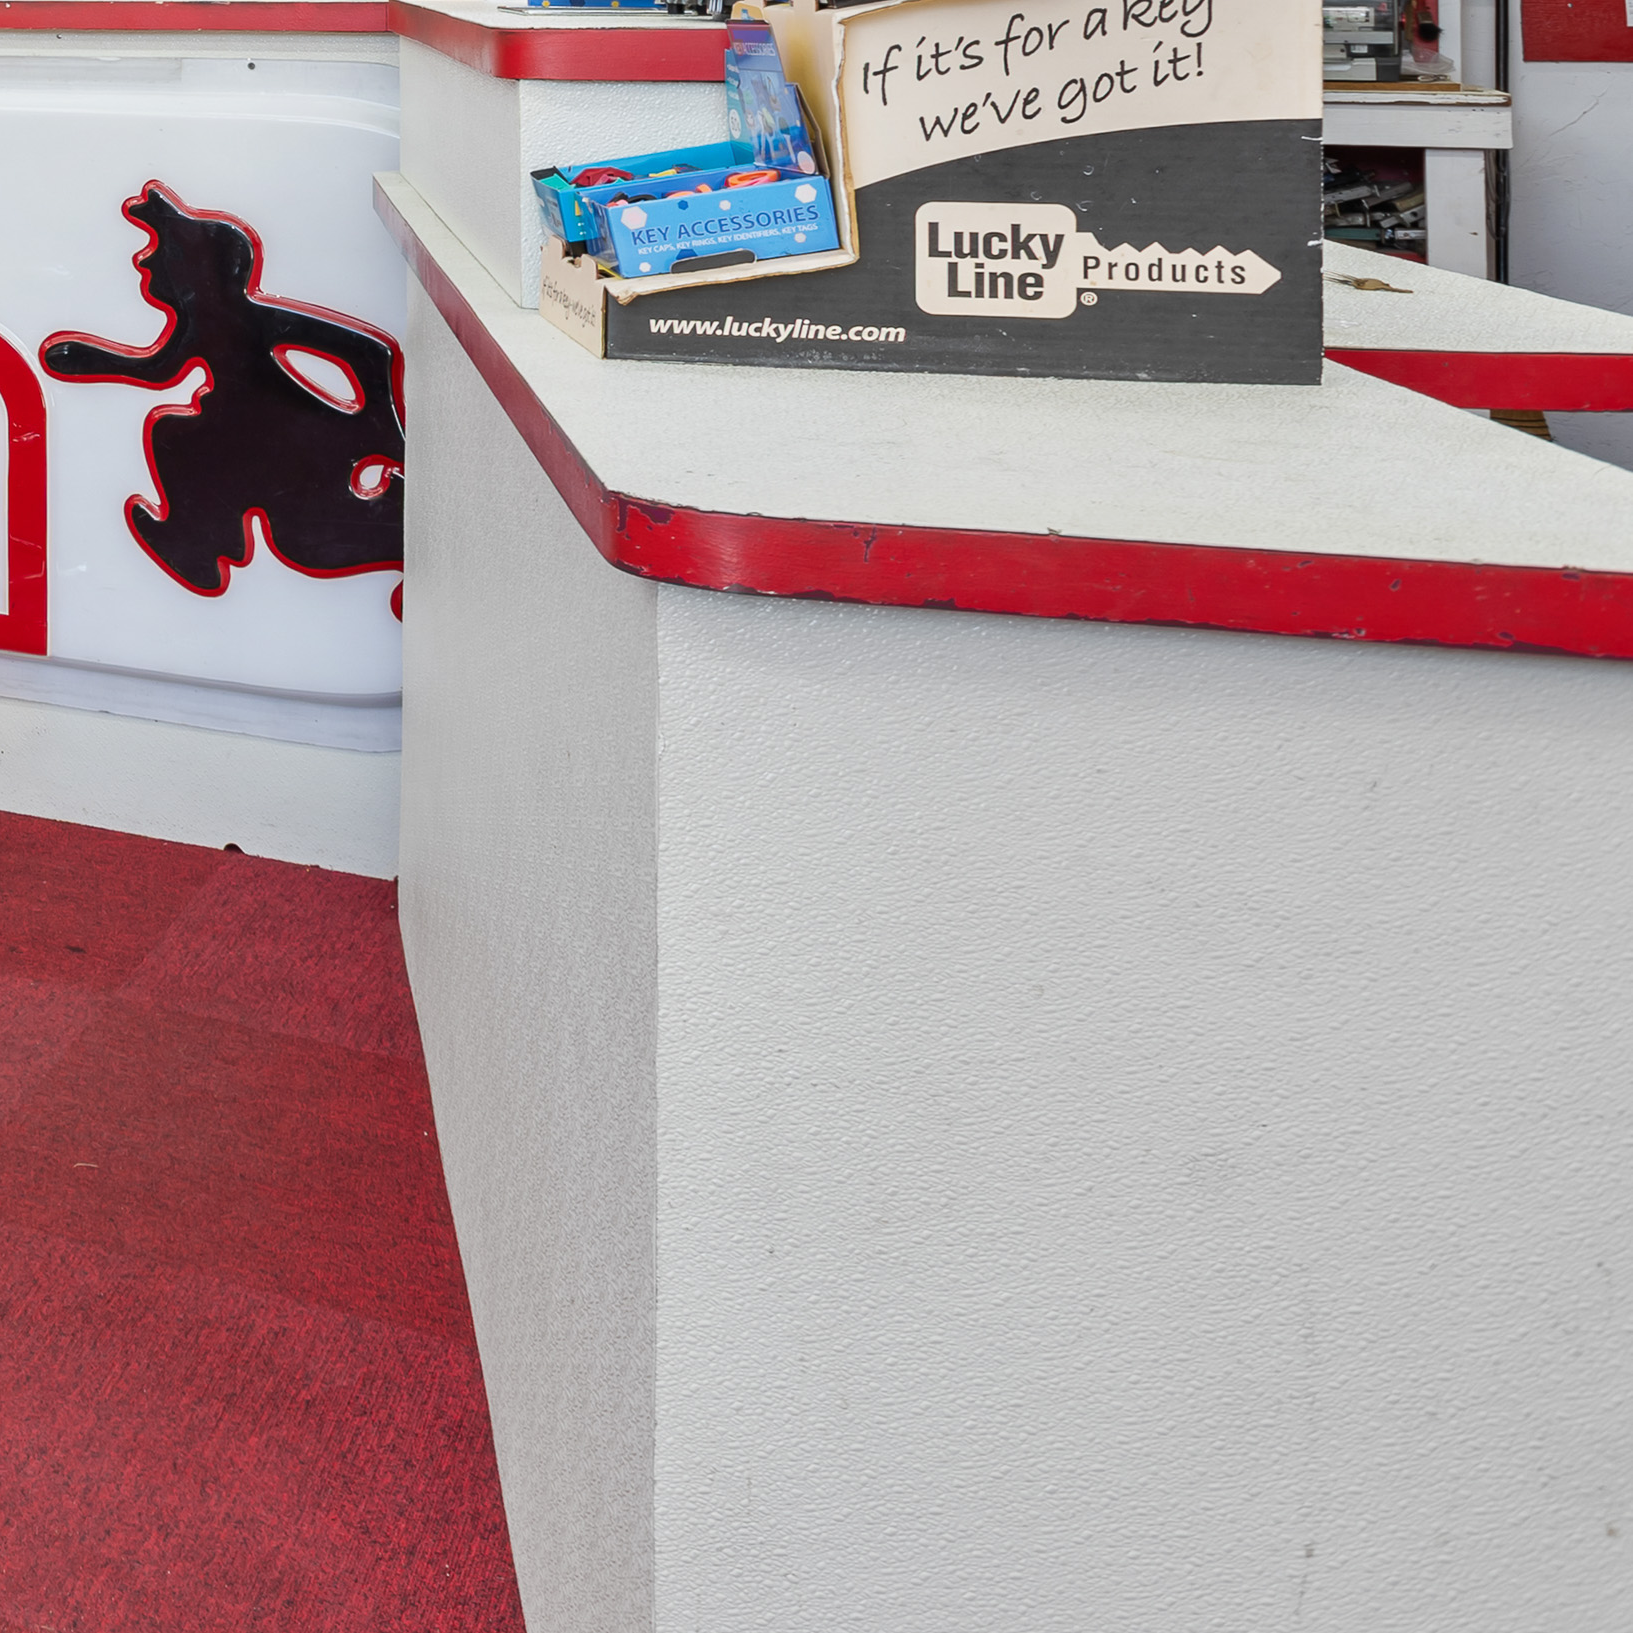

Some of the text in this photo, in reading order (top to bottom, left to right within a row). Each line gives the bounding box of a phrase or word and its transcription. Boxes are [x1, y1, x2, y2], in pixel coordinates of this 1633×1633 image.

[863, 43, 903, 106] If
[914, 34, 985, 82] it's
[994, 13, 1071, 76] for
[1082, 7, 1108, 40] a
[918, 41, 1204, 143] we've got it!
[631, 203, 821, 247] KEY ACCESSORIES
[638, 222, 819, 256] KEY CAPS, KEY RINGS, KEY IDENTIFIERS, KEY TAGS
[927, 220, 1066, 270] Lucky
[946, 261, 1045, 302] Line
[1083, 255, 1248, 286] Products
[648, 315, 908, 344] www.luckyline.com
